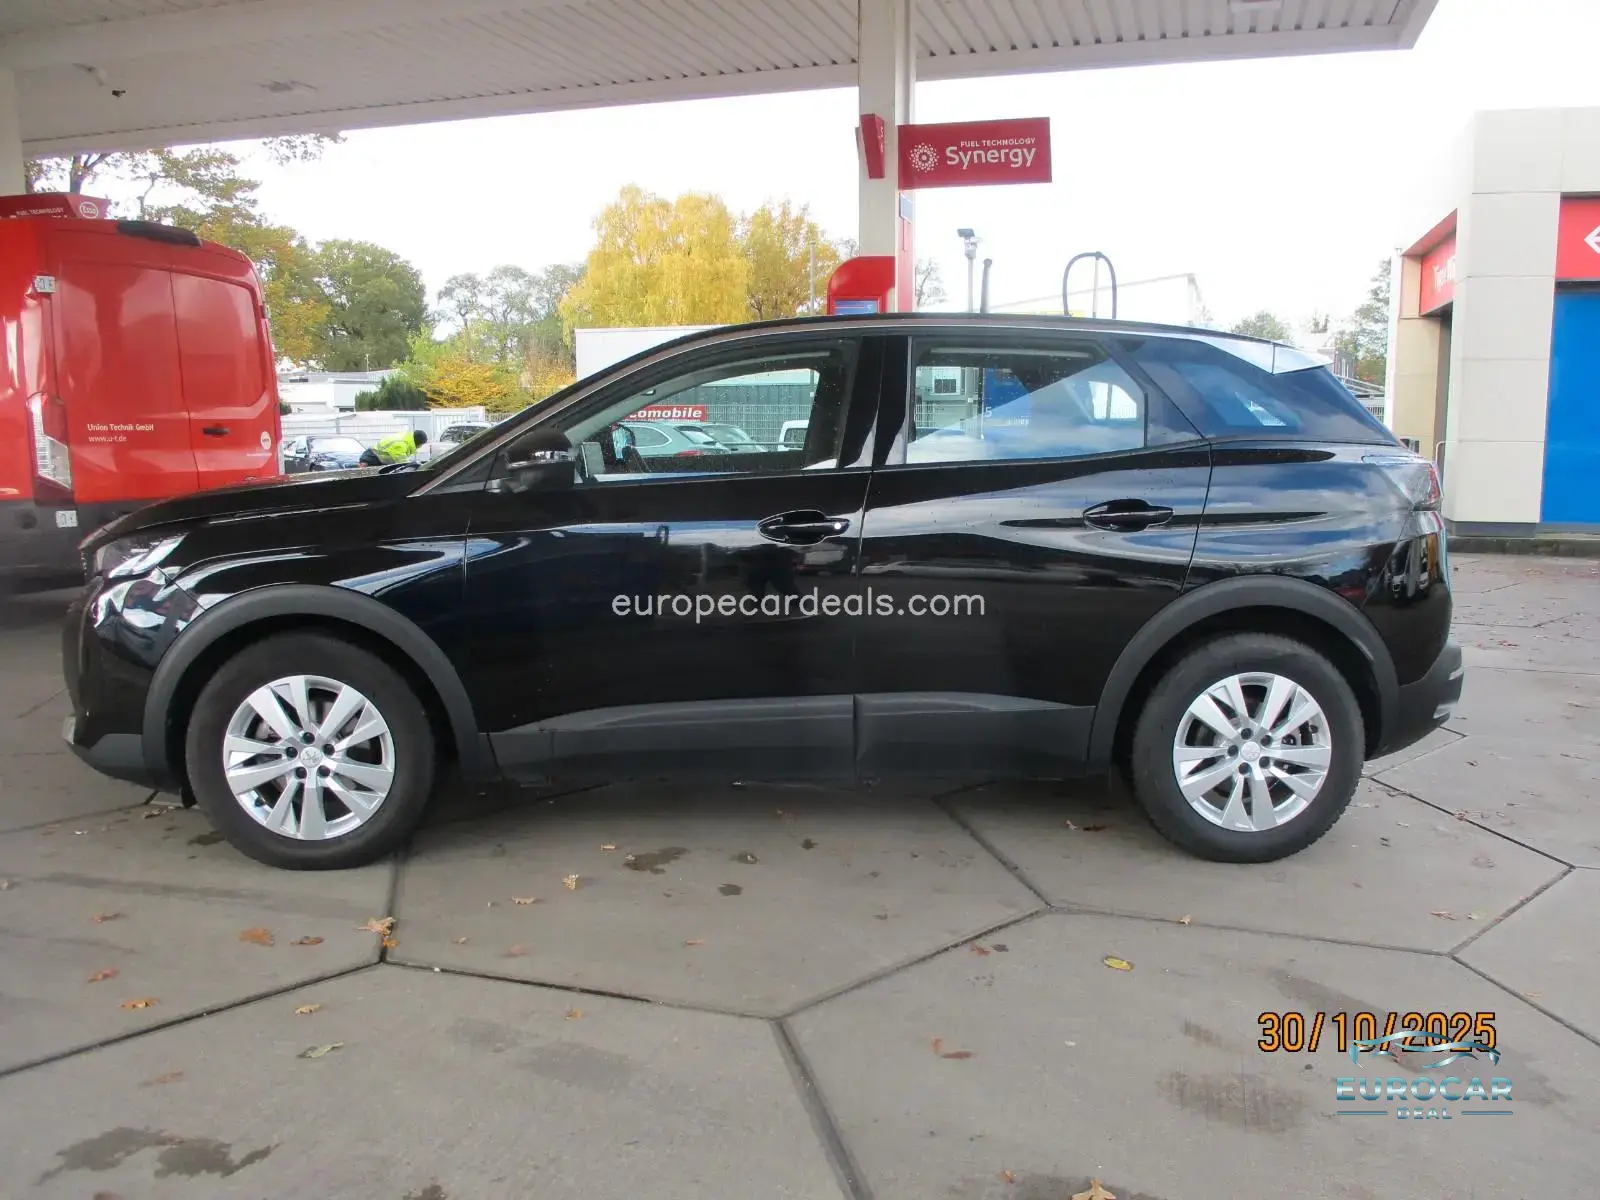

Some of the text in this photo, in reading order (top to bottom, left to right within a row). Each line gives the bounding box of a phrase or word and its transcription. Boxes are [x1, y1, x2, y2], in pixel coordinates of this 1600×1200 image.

[961, 137, 1036, 148] FUEL TECHNOLOGY
[946, 146, 1036, 170] Synergy
[87, 423, 154, 431] Union Technik GmbH
